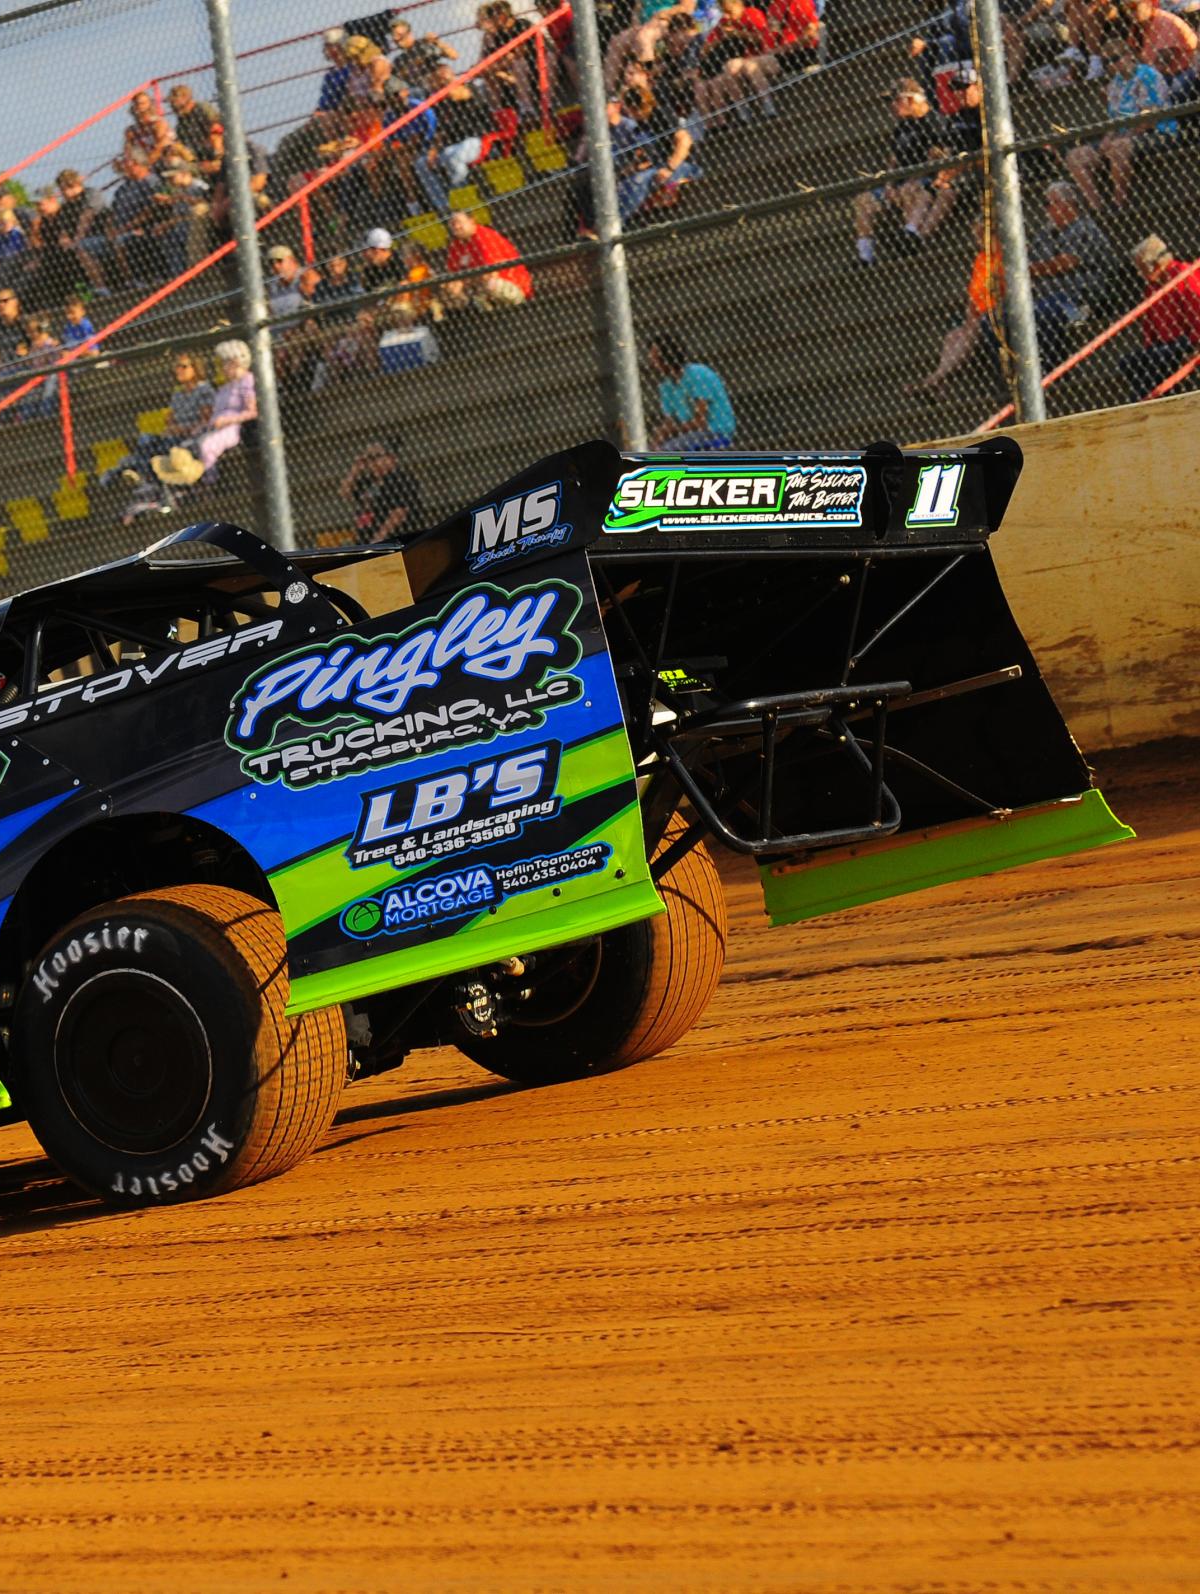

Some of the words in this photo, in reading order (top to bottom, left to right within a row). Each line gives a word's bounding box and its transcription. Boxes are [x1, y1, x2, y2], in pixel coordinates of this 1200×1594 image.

[618, 478, 776, 508] SLICKER
[784, 473, 809, 492] THE
[810, 472, 862, 491] SLICKER
[788, 491, 811, 509] THE
[811, 491, 857, 509] BETTER
[908, 464, 962, 520] 11
[471, 485, 558, 554] MS
[237, 591, 557, 738] Pingley
[248, 698, 494, 777] TRUCKING,
[504, 680, 570, 710] LLC
[362, 750, 547, 843] LB'S
[353, 842, 398, 864] Tree
[402, 835, 417, 851] &
[421, 799, 555, 846] Landscaping
[393, 822, 517, 866] 540-336-3560
[496, 844, 603, 881] HeflinTeam.com
[502, 855, 597, 890] 540.635.0404
[384, 886, 495, 927] MORTGAGE
[385, 870, 492, 913] ALCOVA
[31, 921, 150, 1003] Hoosier
[112, 1121, 235, 1196] Hoosier
